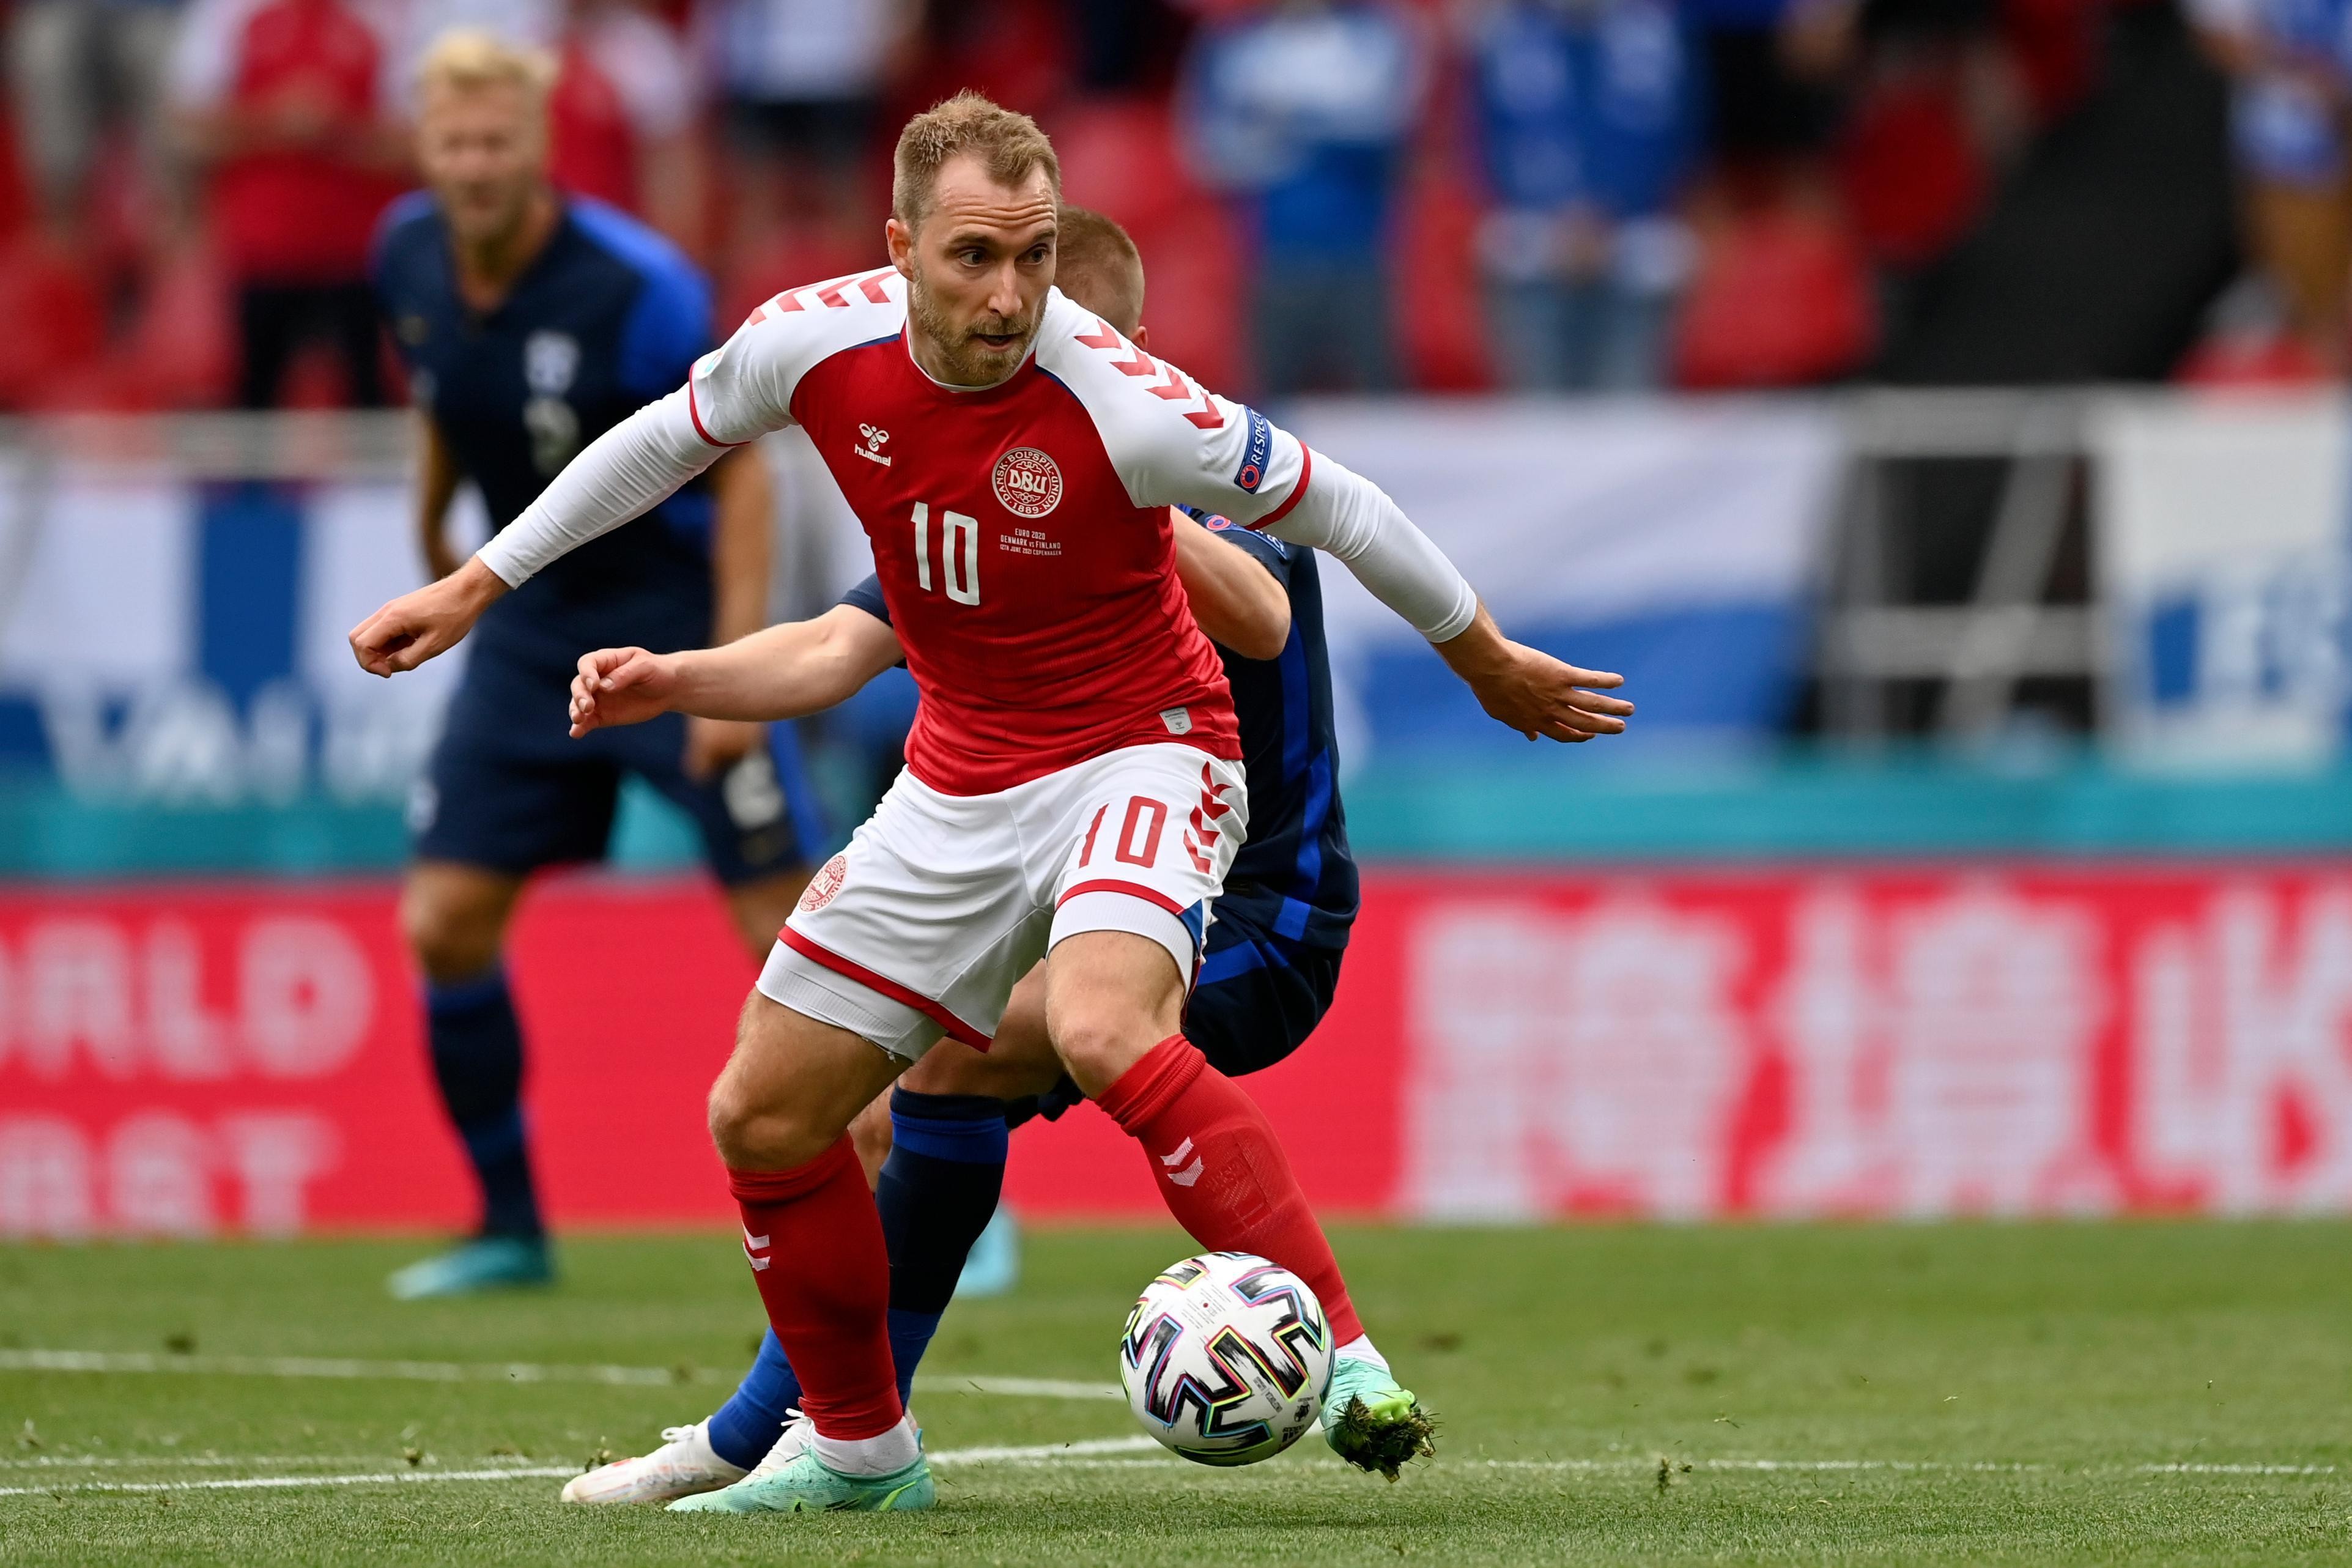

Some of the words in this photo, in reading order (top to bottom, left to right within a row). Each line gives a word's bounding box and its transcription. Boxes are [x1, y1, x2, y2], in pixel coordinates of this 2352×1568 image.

[854, 443, 891, 467] hummel
[1008, 468, 1047, 494] DBU
[1000, 534, 1027, 546] DENMARK
[1035, 541, 1061, 549] FINLAND
[1015, 528, 1030, 538] EURO
[1031, 531, 1045, 540] 2020
[911, 501, 980, 605] 10
[1078, 796, 1167, 868] 10
